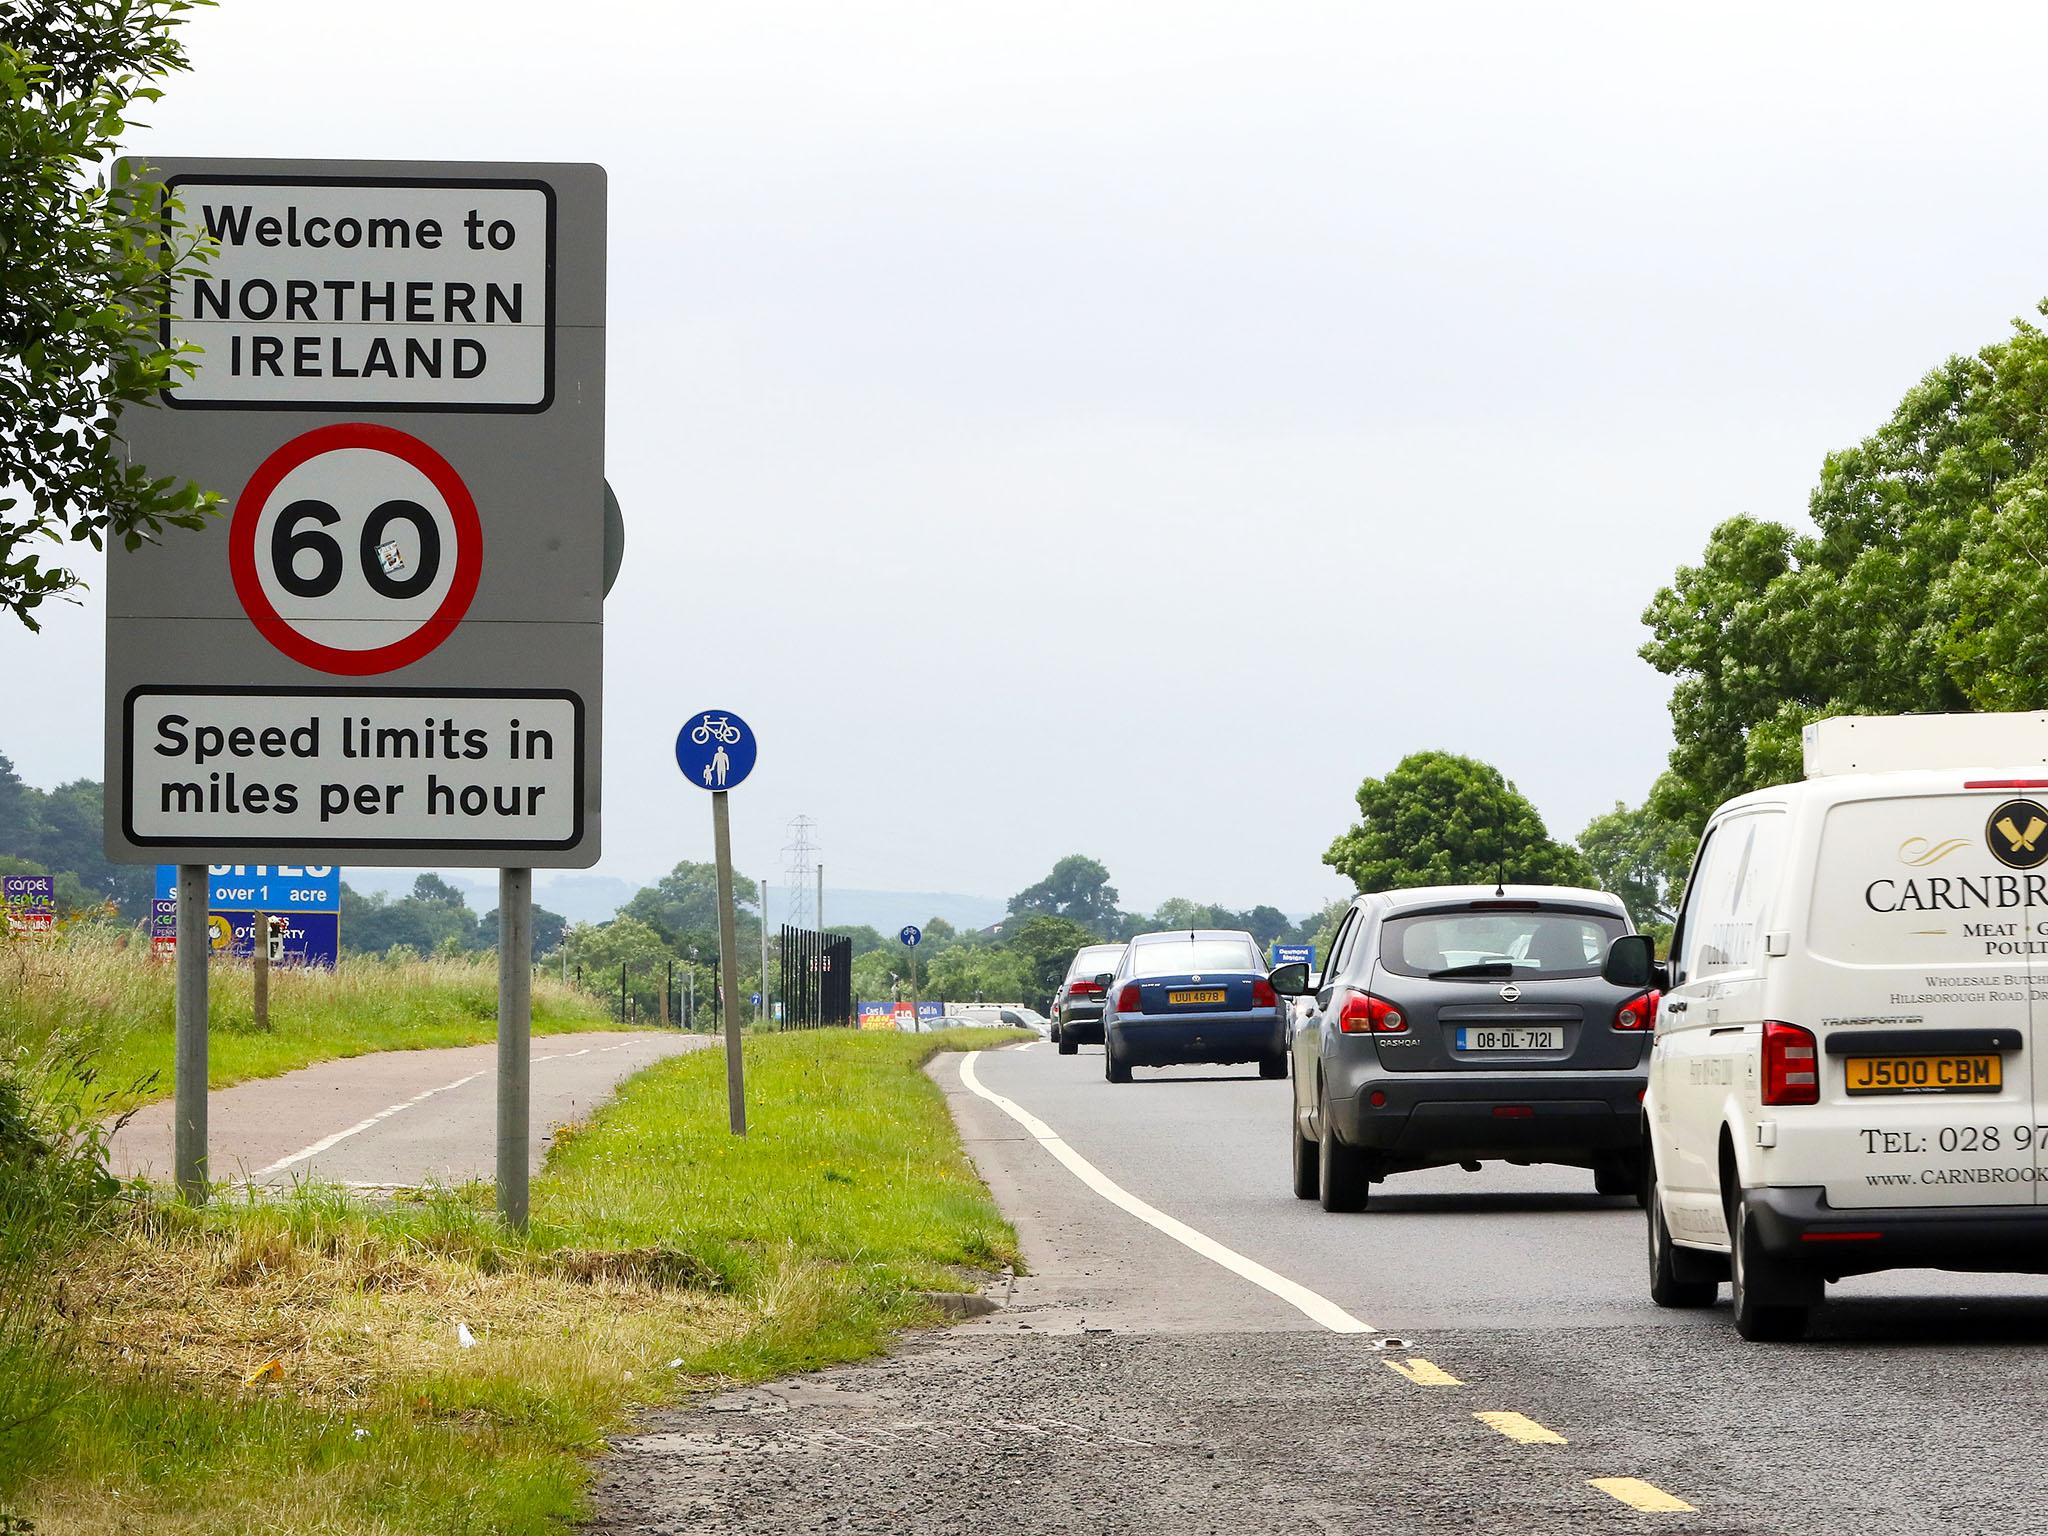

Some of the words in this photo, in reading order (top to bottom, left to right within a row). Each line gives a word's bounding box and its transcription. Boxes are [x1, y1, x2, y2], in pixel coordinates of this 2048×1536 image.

[202, 205, 442, 249] Welcome
[464, 209, 516, 251] to
[193, 278, 522, 323] NORTHERN
[231, 336, 487, 379] IRELAND
[271, 499, 440, 600] 60
[154, 714, 320, 765] Speed
[343, 717, 488, 759] limits
[510, 719, 553, 760] in
[161, 772, 298, 814] miles
[320, 782, 403, 822] per
[427, 774, 546, 816] hour
[8, 879, 48, 893] carpet
[216, 888, 255, 901] over
[260, 886, 268, 901] 1
[290, 889, 327, 901] acre
[1963, 924, 2018, 937] MEAT
[1925, 976, 2000, 987] WHOLESALE
[1194, 992, 1219, 1002] 4878
[1890, 992, 1985, 1004] HILLSBOROUGH
[1821, 1015, 1924, 1026] TRANSPORTER
[1379, 1039, 1421, 1047] QASHQAI
[1477, 1032, 1552, 1048] 08-DL-7121
[1858, 1061, 1928, 1085] J500
[1937, 1059, 1989, 1084] CBM
[1939, 1126, 2000, 1152] 028
